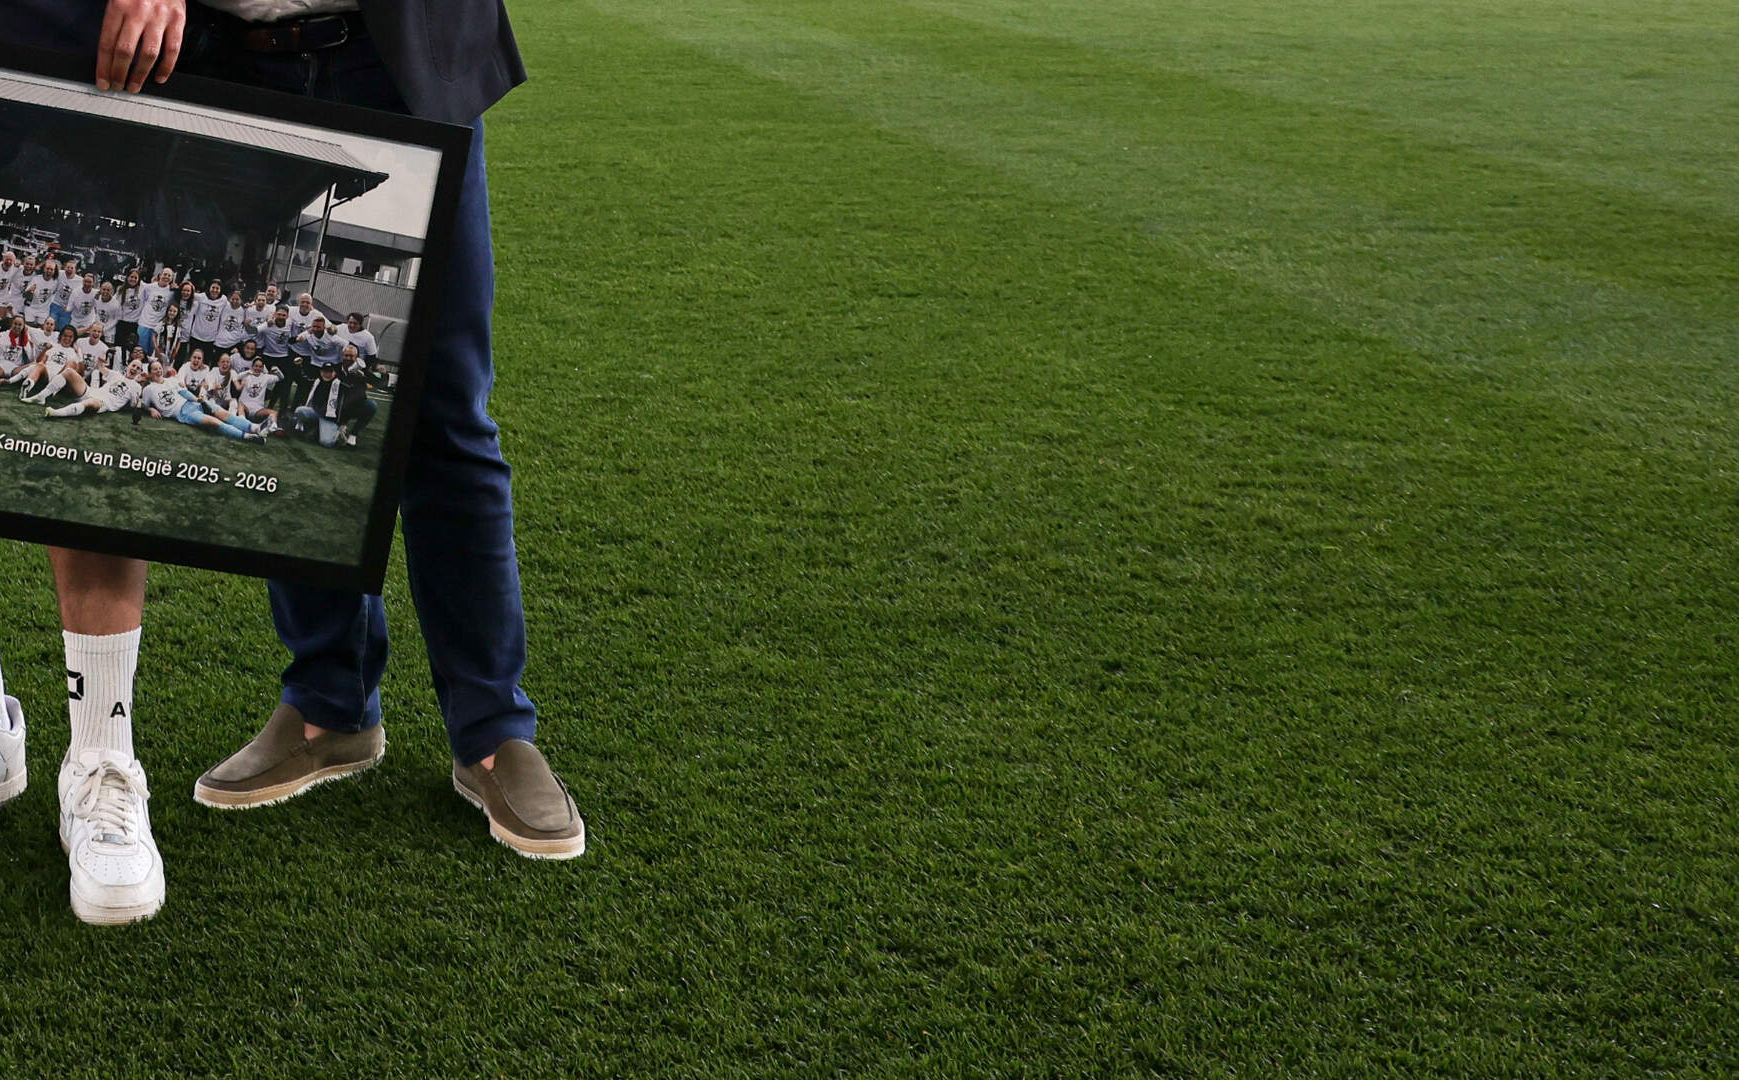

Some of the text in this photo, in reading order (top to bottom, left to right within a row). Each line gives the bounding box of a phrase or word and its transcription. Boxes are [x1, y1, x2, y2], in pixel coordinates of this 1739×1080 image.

[83, 451, 113, 467] van
[119, 453, 172, 476] België
[177, 462, 219, 483] 2025
[235, 471, 278, 493] 2026
